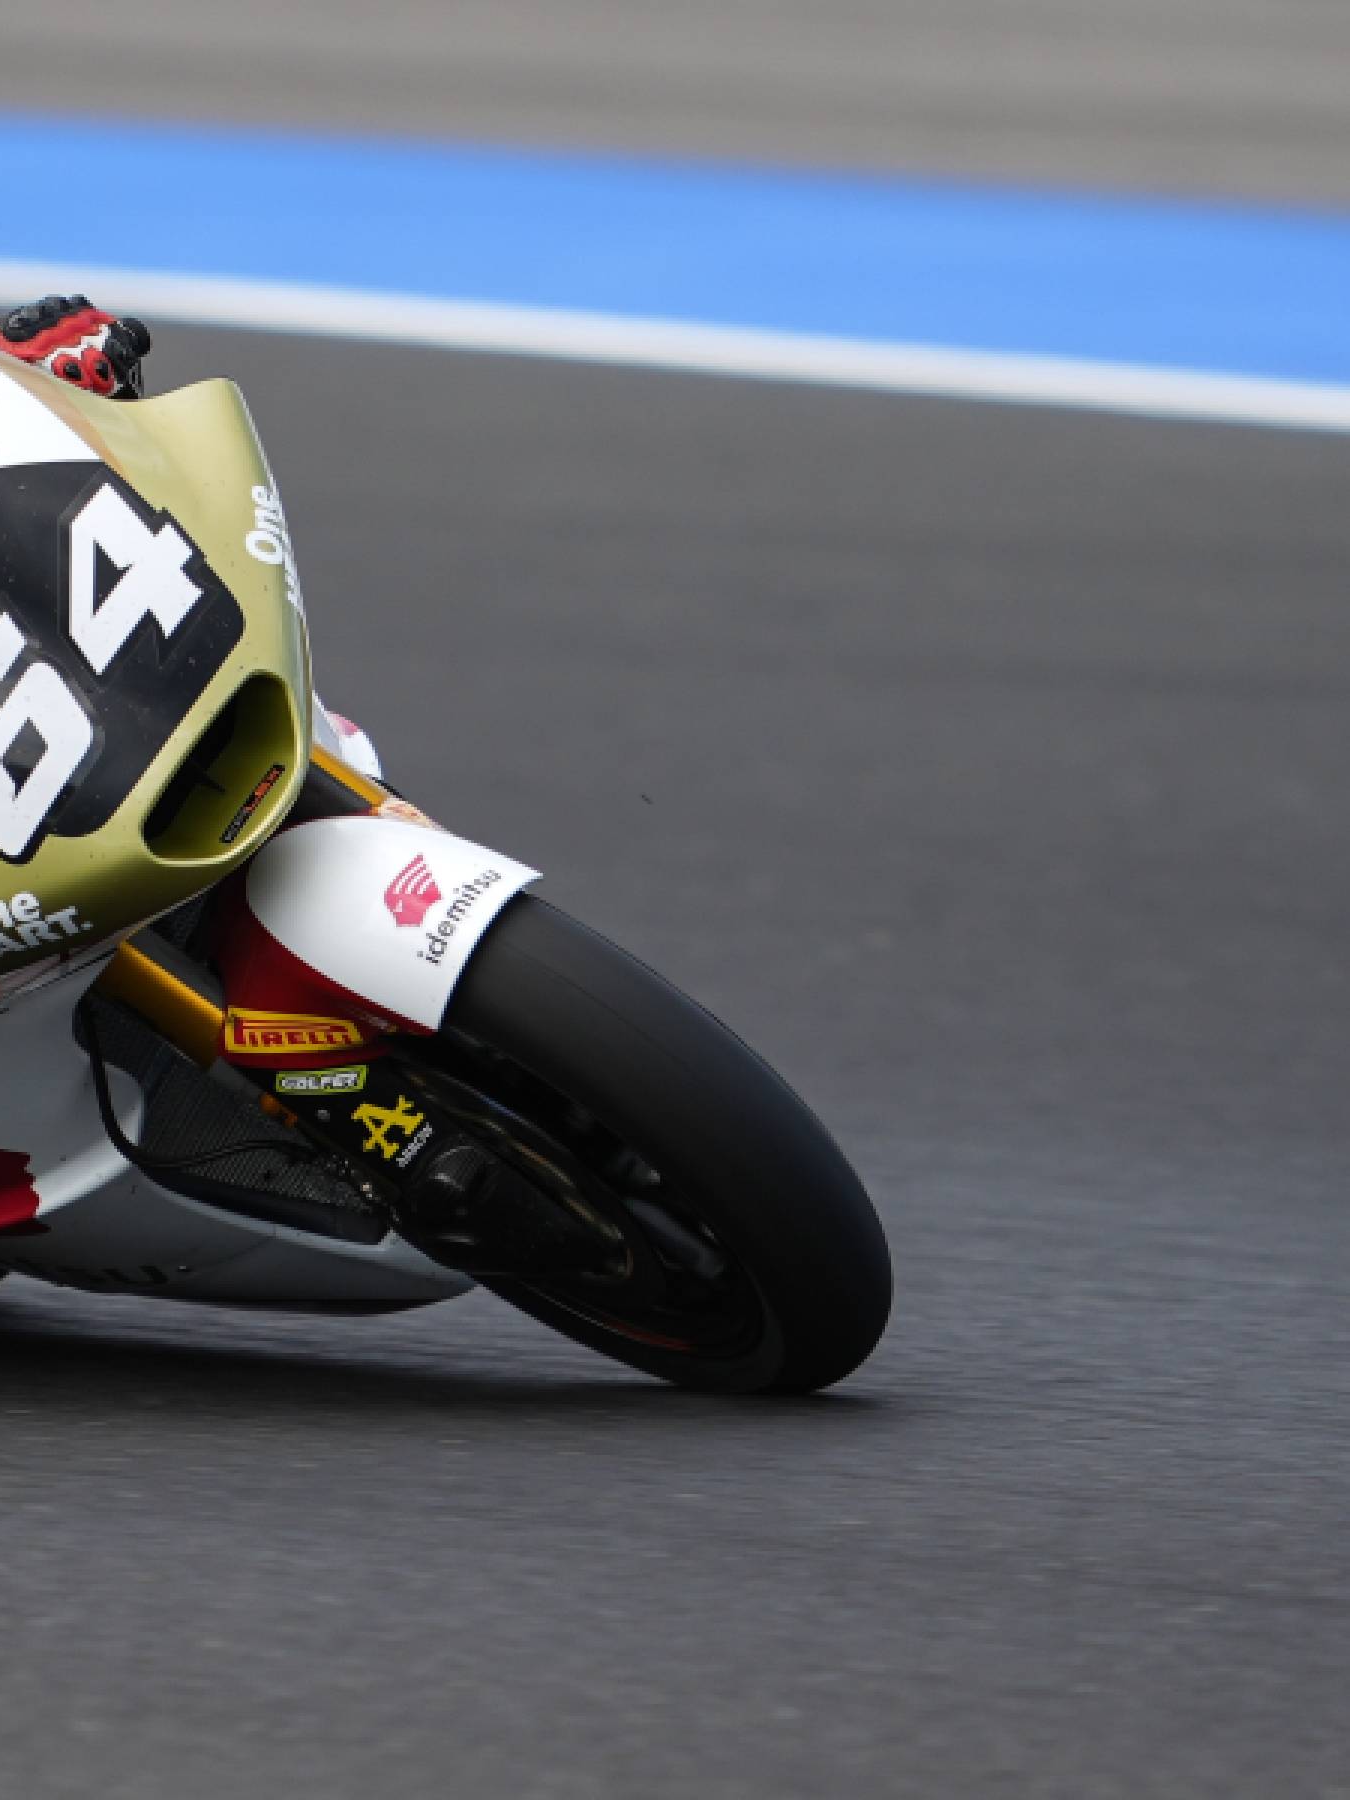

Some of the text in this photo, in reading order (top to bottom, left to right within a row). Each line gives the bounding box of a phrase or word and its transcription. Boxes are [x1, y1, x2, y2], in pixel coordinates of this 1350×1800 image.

[245, 486, 283, 565] One
[417, 869, 503, 967] idemitsu
[232, 1014, 354, 1048] PIRELLI
